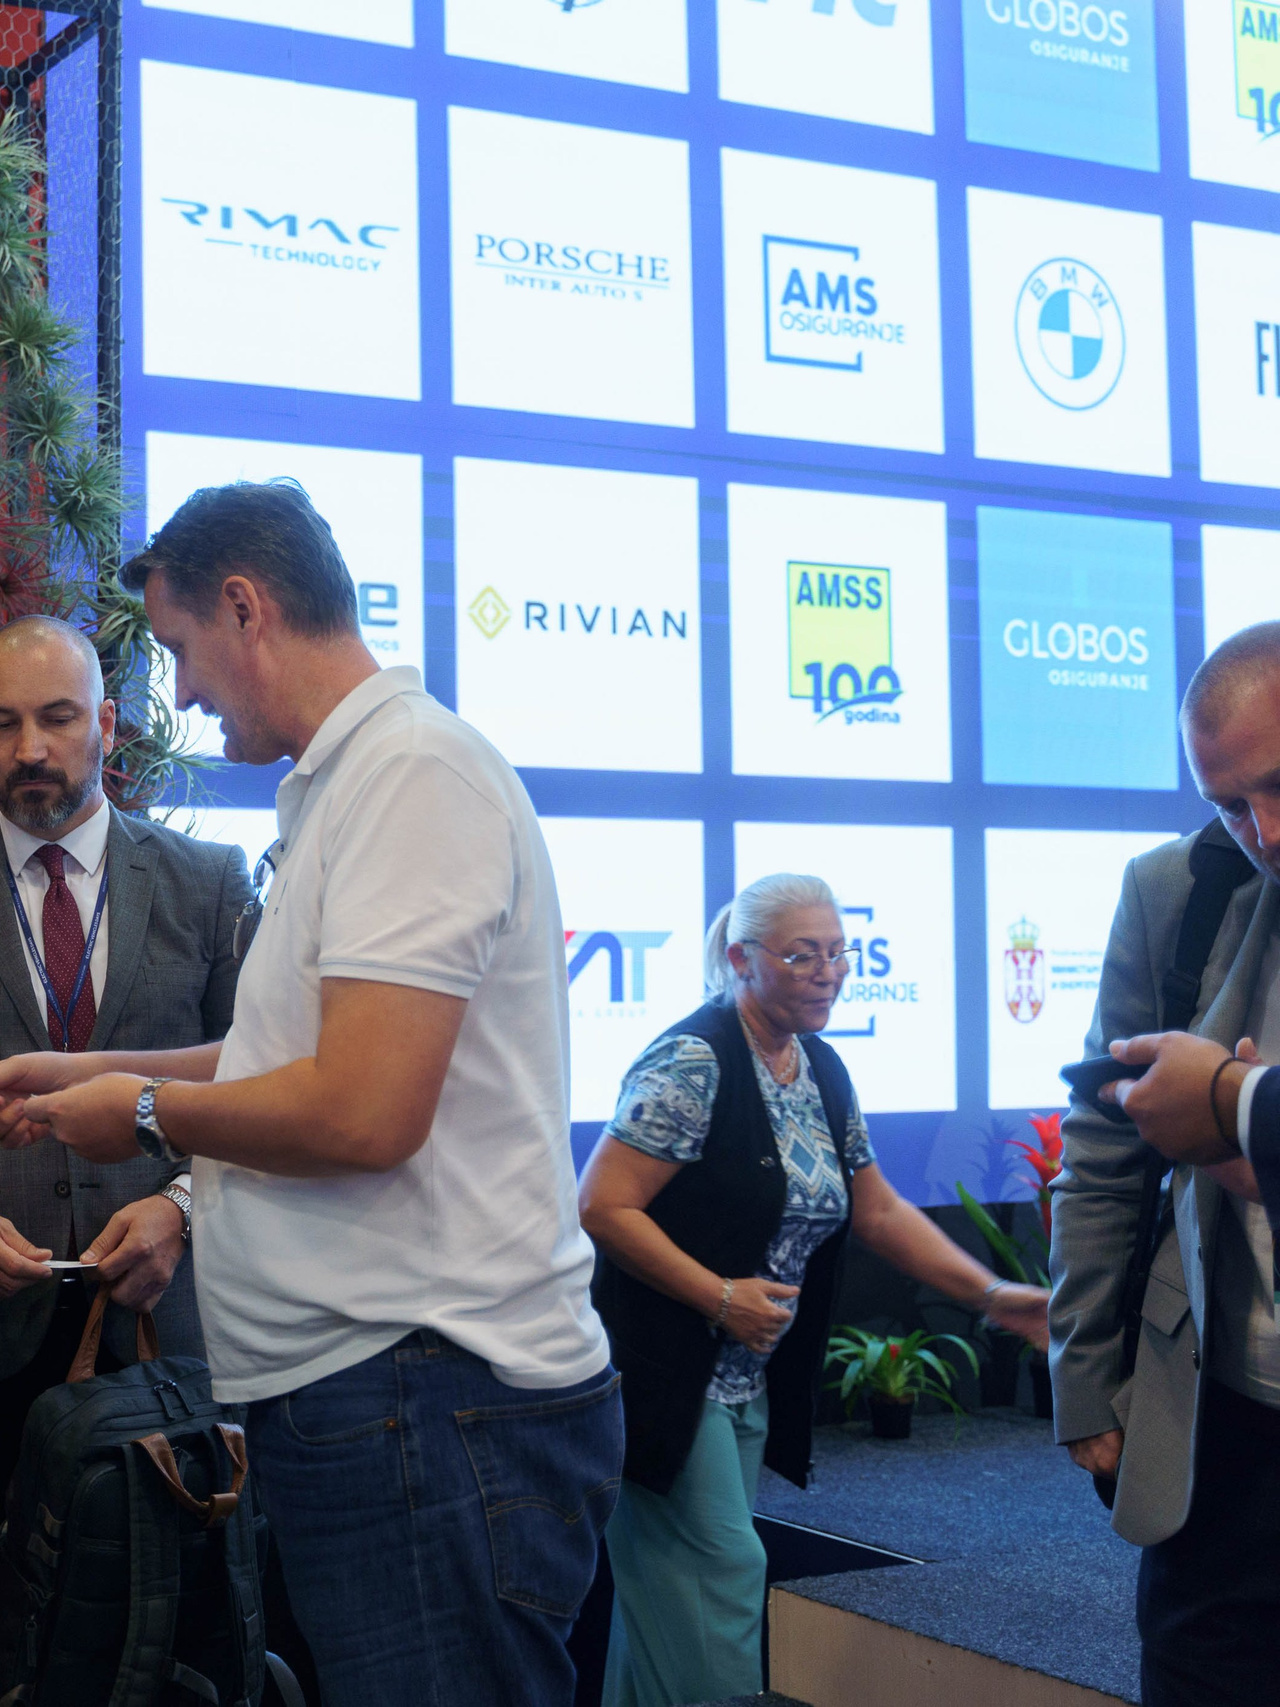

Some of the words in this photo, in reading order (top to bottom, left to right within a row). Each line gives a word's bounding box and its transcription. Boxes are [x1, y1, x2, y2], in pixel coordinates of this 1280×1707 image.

[985, 0, 1129, 47] GLOBOS
[1241, 6, 1280, 43] AM
[1029, 39, 1130, 73] OSIGURANJE
[161, 198, 400, 249] RIMAC
[250, 243, 381, 272] TECHNOLOGY
[475, 233, 670, 283] PORSCHE
[504, 273, 562, 294] INTER
[569, 281, 624, 300] AUTO
[780, 267, 878, 317] AMS
[779, 310, 907, 345] OSIGURANJE
[796, 570, 883, 611] AMSS
[525, 601, 687, 639] RIVIAN
[1004, 618, 1149, 665] GLOBOS
[804, 661, 902, 713] 100
[1048, 668, 1149, 691] OSIGURANJE
[844, 707, 901, 726] godina
[841, 982, 919, 1003] URANJE
